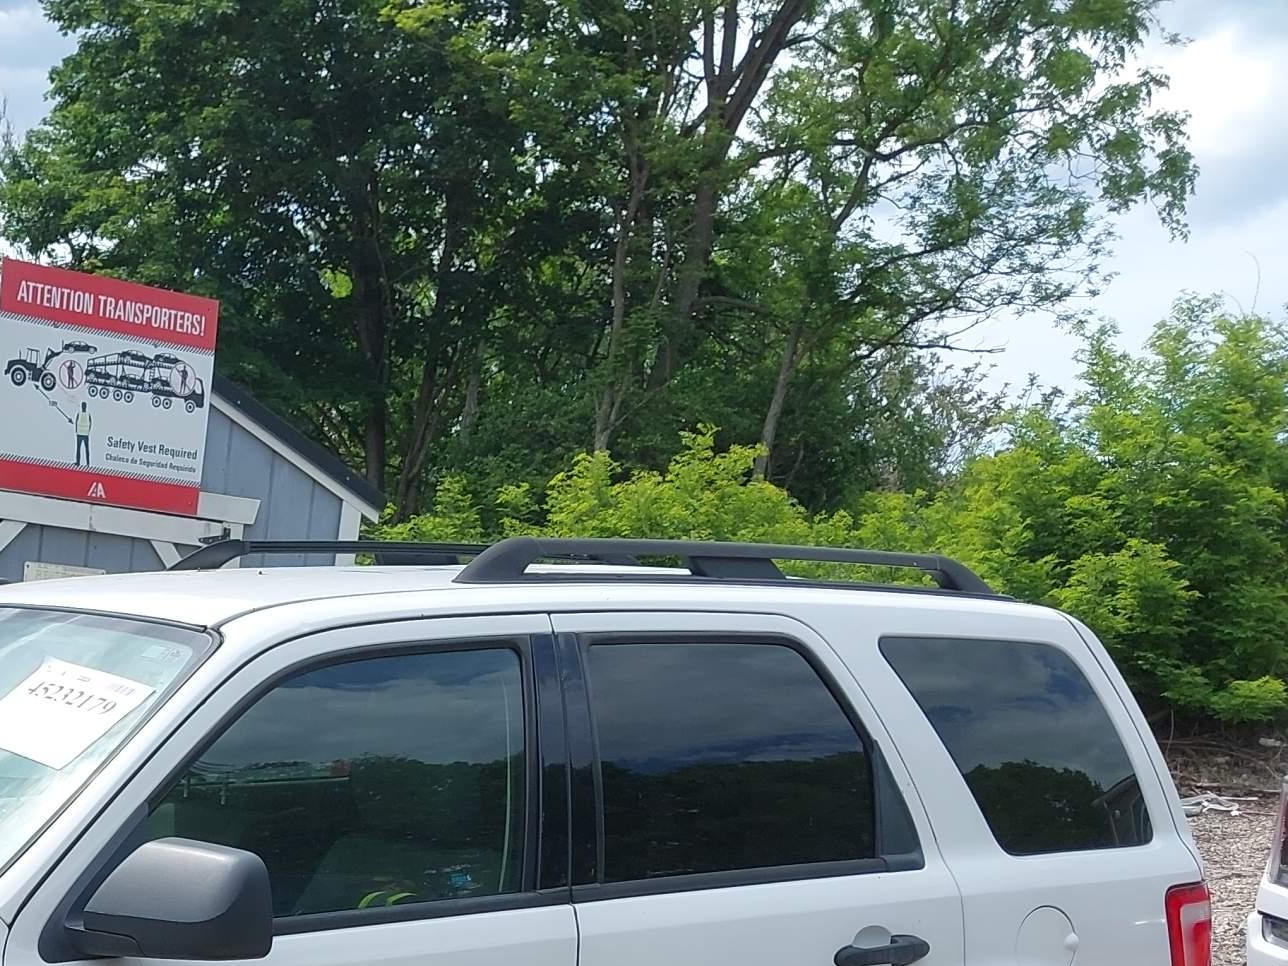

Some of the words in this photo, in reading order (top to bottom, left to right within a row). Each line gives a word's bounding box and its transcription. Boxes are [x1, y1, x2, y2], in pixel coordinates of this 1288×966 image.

[17, 280, 94, 315] ATTENTION
[98, 295, 206, 336] TRANSPORTERS!
[107, 436, 135, 453] Safety
[137, 441, 157, 455] Vest
[159, 444, 198, 460] Required
[27, 681, 118, 714] 45232179
